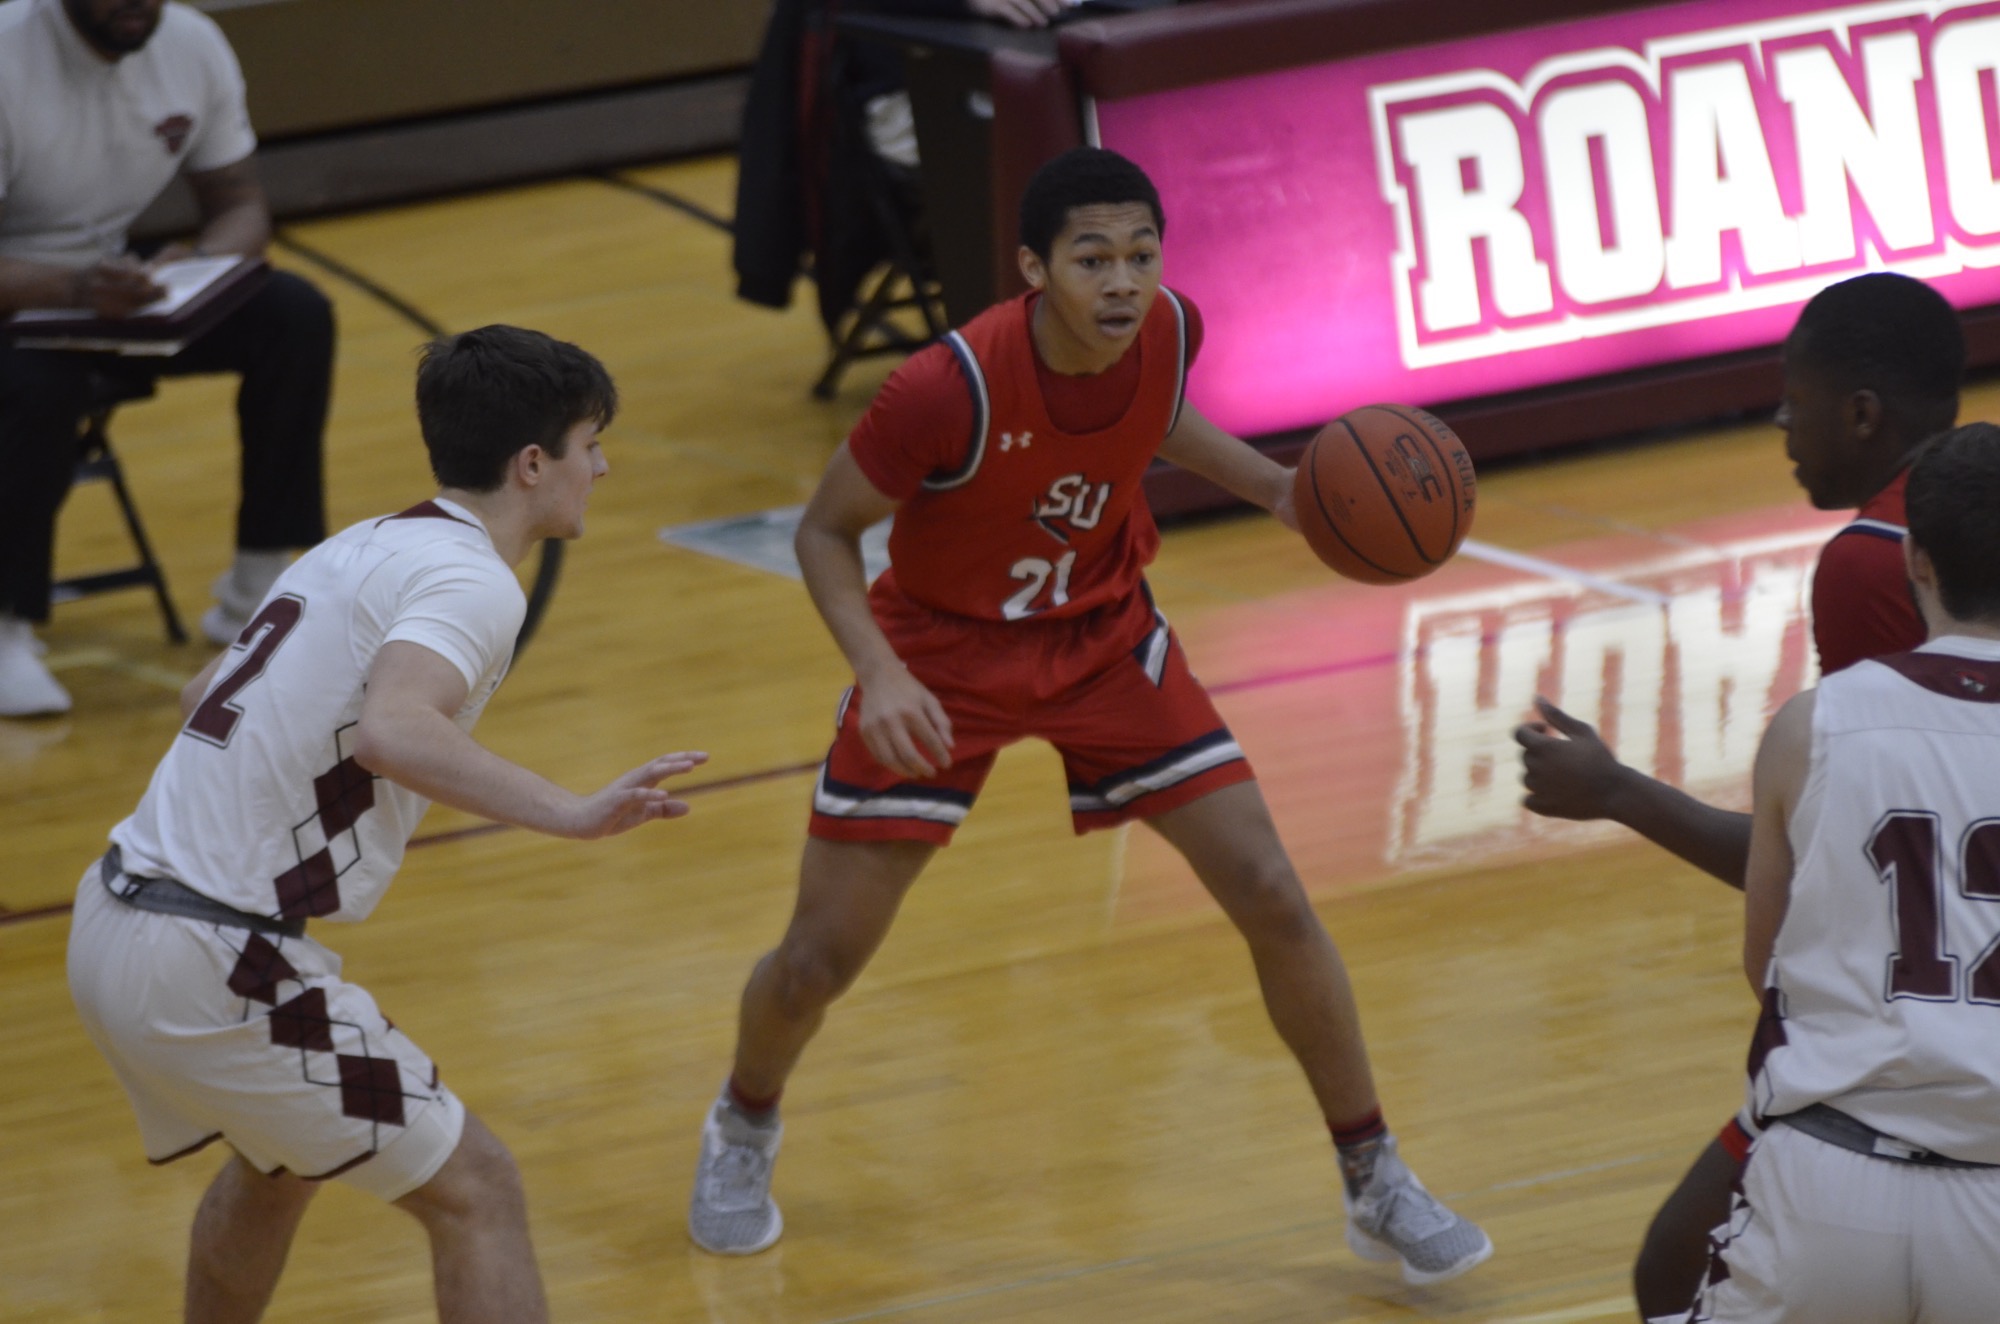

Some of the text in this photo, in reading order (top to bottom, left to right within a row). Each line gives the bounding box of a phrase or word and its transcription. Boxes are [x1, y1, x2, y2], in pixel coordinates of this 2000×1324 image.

[1037, 473, 1111, 530] SU
[1002, 550, 1077, 621] 21
[183, 592, 306, 750] 2
